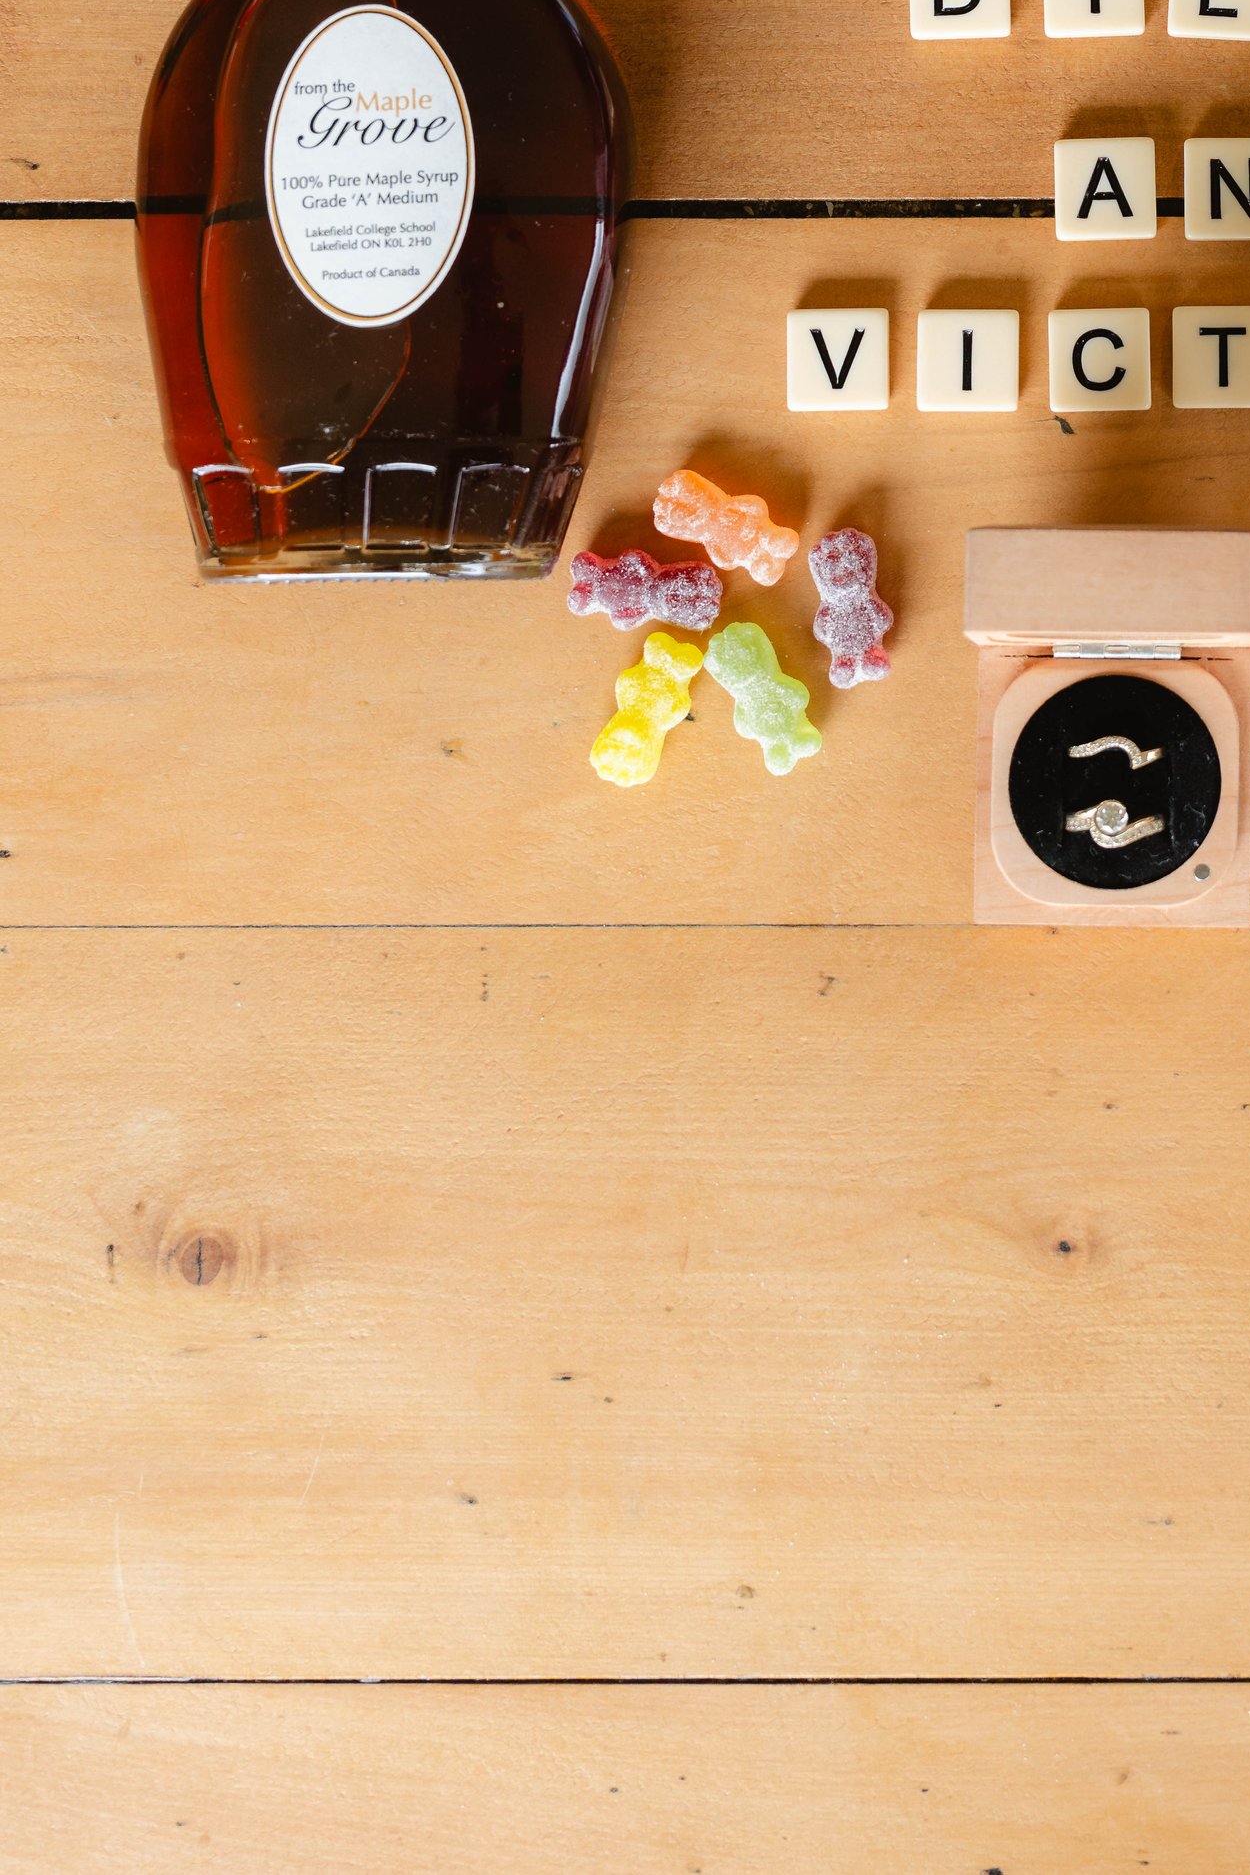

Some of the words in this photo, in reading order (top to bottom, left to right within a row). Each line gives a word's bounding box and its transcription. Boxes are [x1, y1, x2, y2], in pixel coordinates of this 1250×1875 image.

[294, 80, 328, 96] from
[332, 79, 356, 94] the
[356, 87, 433, 118] Maple
[297, 93, 456, 149] Grove
[281, 175, 324, 191] 100%
[328, 173, 361, 188] Pure
[365, 170, 412, 189] Maple
[417, 169, 460, 188] Syrup
[302, 193, 347, 210] Grade
[377, 190, 439, 205] Medium
[305, 225, 353, 239] Lakefield
[356, 223, 397, 237] College
[400, 221, 437, 234] School
[310, 239, 358, 253] Lakefield
[361, 239, 381, 250] ON
[322, 269, 364, 281] Product
[366, 267, 377, 279] of
[380, 265, 421, 278] Canada
